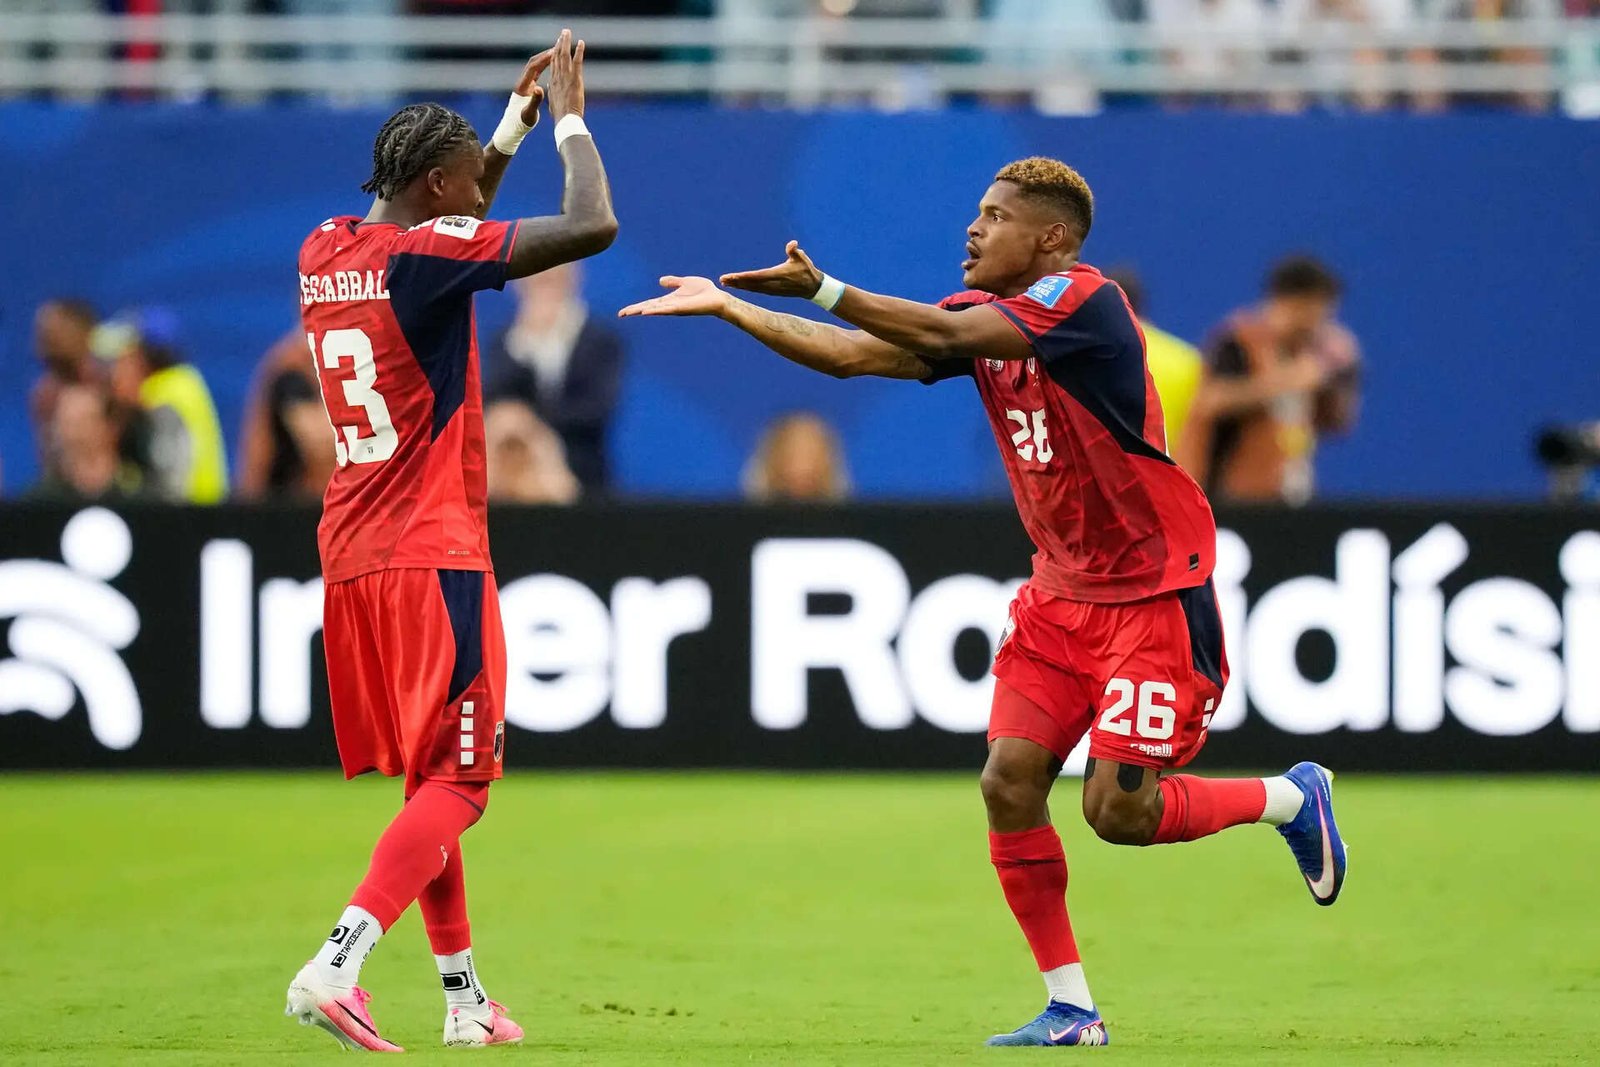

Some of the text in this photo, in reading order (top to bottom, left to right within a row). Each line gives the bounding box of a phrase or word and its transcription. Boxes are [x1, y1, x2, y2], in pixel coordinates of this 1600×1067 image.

[1005, 407, 1054, 463] 26
[200, 538, 712, 733] Iner
[1097, 678, 1177, 740] 26
[340, 919, 369, 955] TAPEDESIGN
